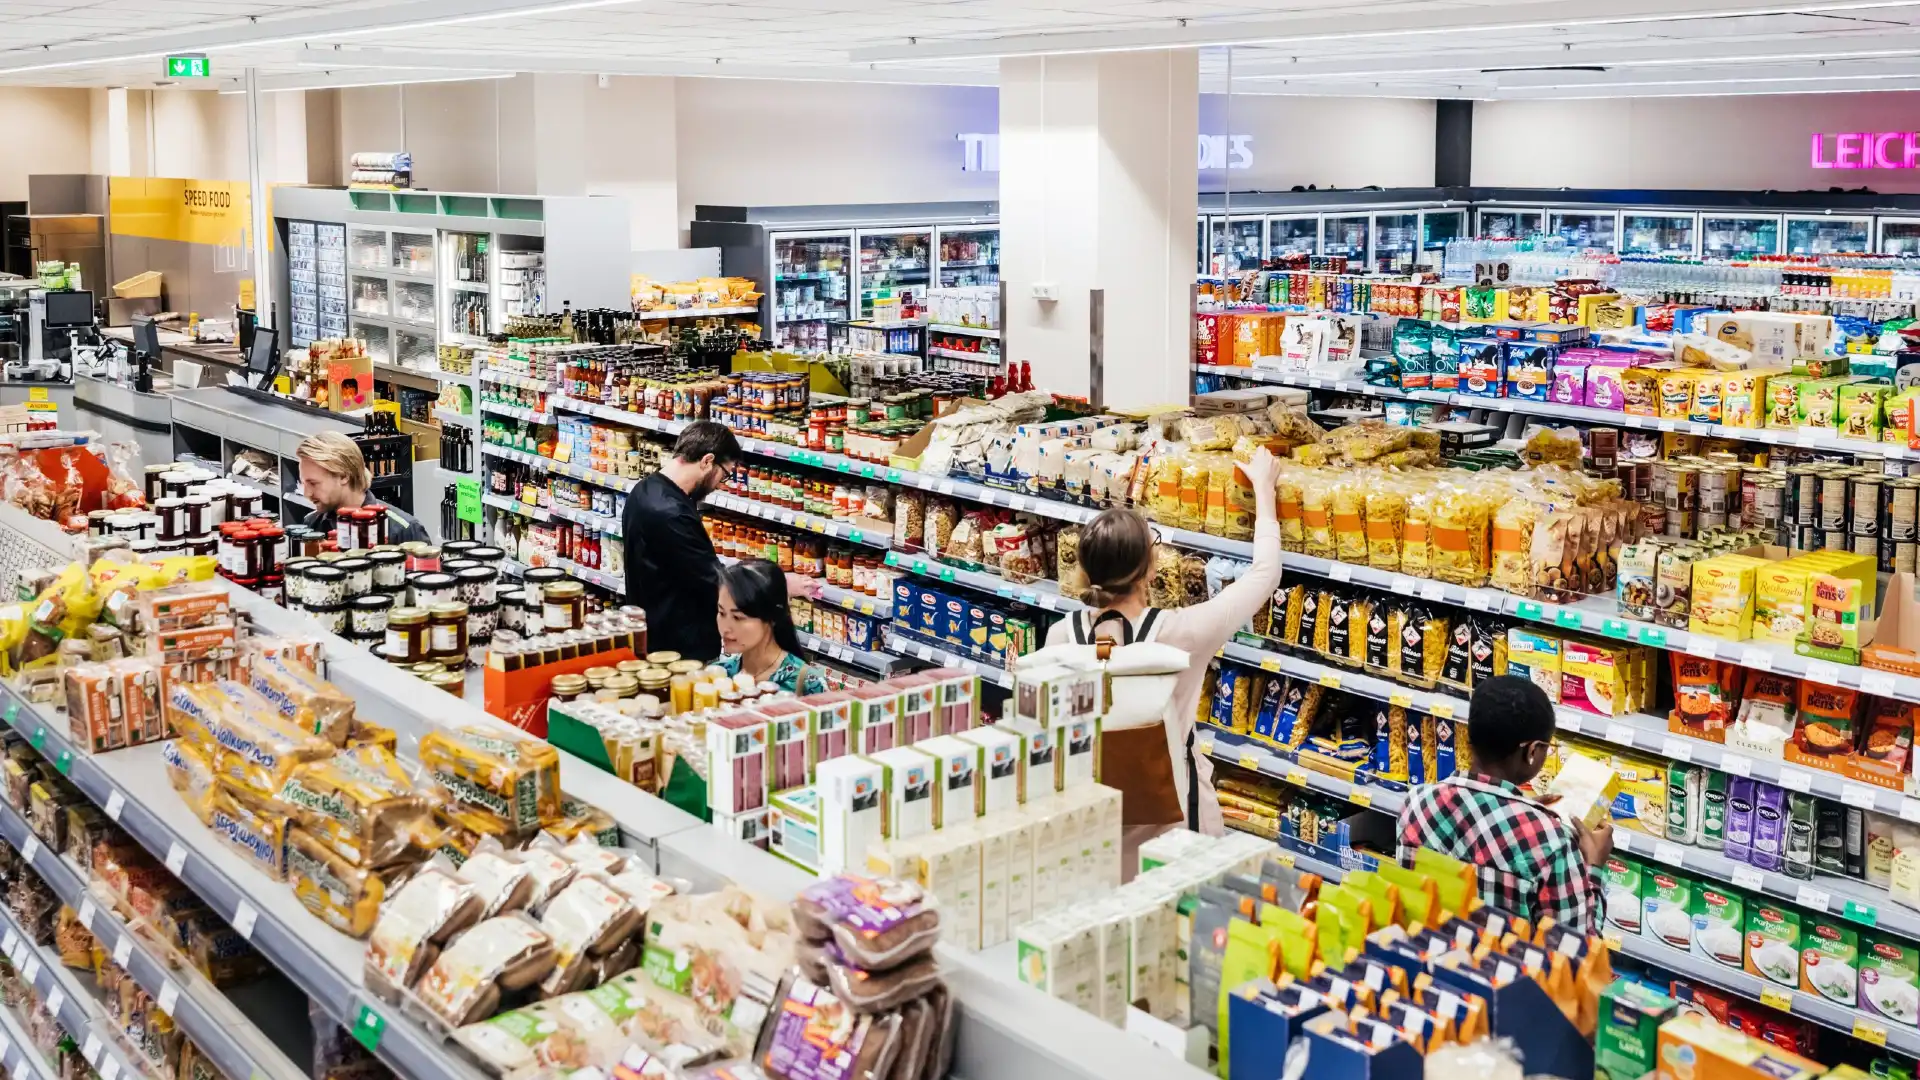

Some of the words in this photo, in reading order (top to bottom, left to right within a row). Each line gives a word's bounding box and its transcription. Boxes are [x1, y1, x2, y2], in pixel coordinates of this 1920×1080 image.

[184, 190, 207, 207] SPEED
[209, 191, 231, 208] FOOD
[1405, 359, 1430, 372] ONE
[1695, 574, 1737, 591] Reiskugeln
[1760, 579, 1803, 597] Reiskugeln
[1736, 740, 1773, 754] CLASSIC
[1855, 771, 1897, 787] EXPRESS
[1731, 800, 1751, 810] ORYZA
[1758, 808, 1777, 818] ORYZA
[1607, 870, 1626, 879] Milch
[1655, 886, 1675, 897] Milch
[1705, 903, 1725, 914] Milch
[1752, 917, 1791, 935] Parboiled
[1808, 934, 1848, 951] Parboiled
